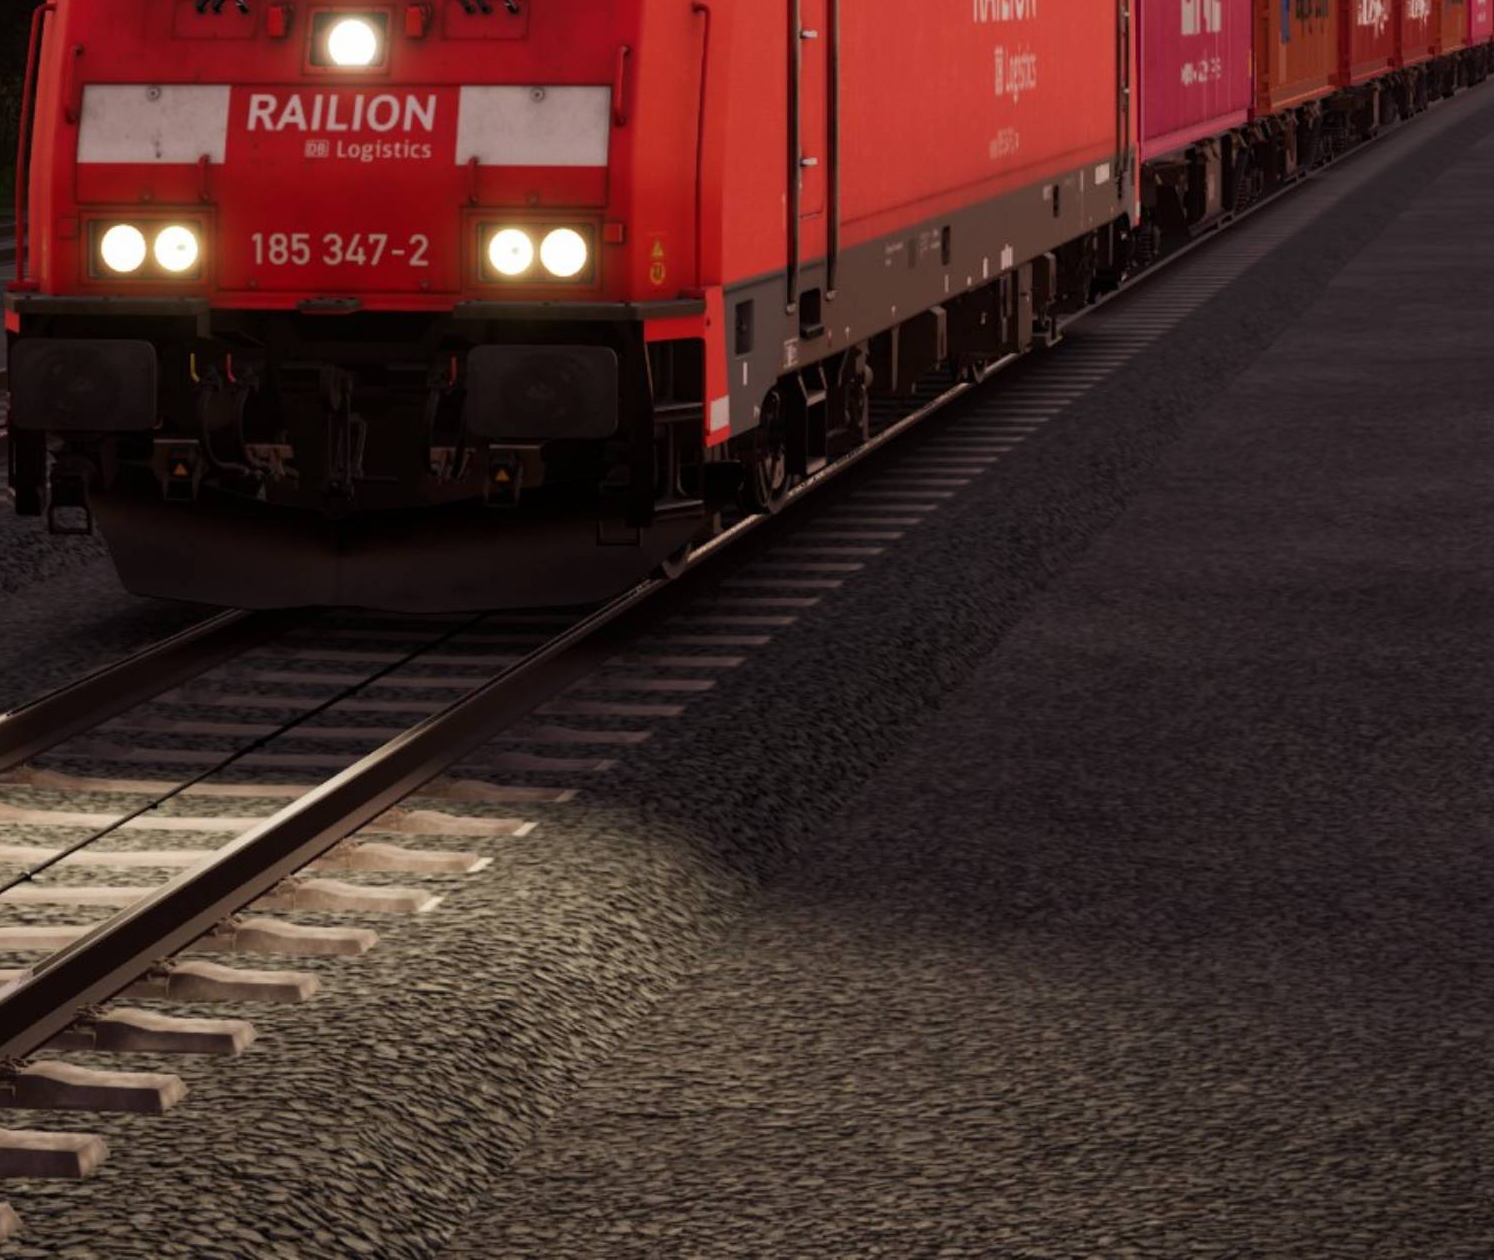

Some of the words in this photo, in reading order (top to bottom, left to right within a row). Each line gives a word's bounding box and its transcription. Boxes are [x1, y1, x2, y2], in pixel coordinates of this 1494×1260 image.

[247, 94, 437, 132] RAILION
[305, 140, 329, 158] DB
[336, 140, 432, 162] Logistics
[252, 232, 311, 265] 185
[322, 232, 429, 266] 347-2
